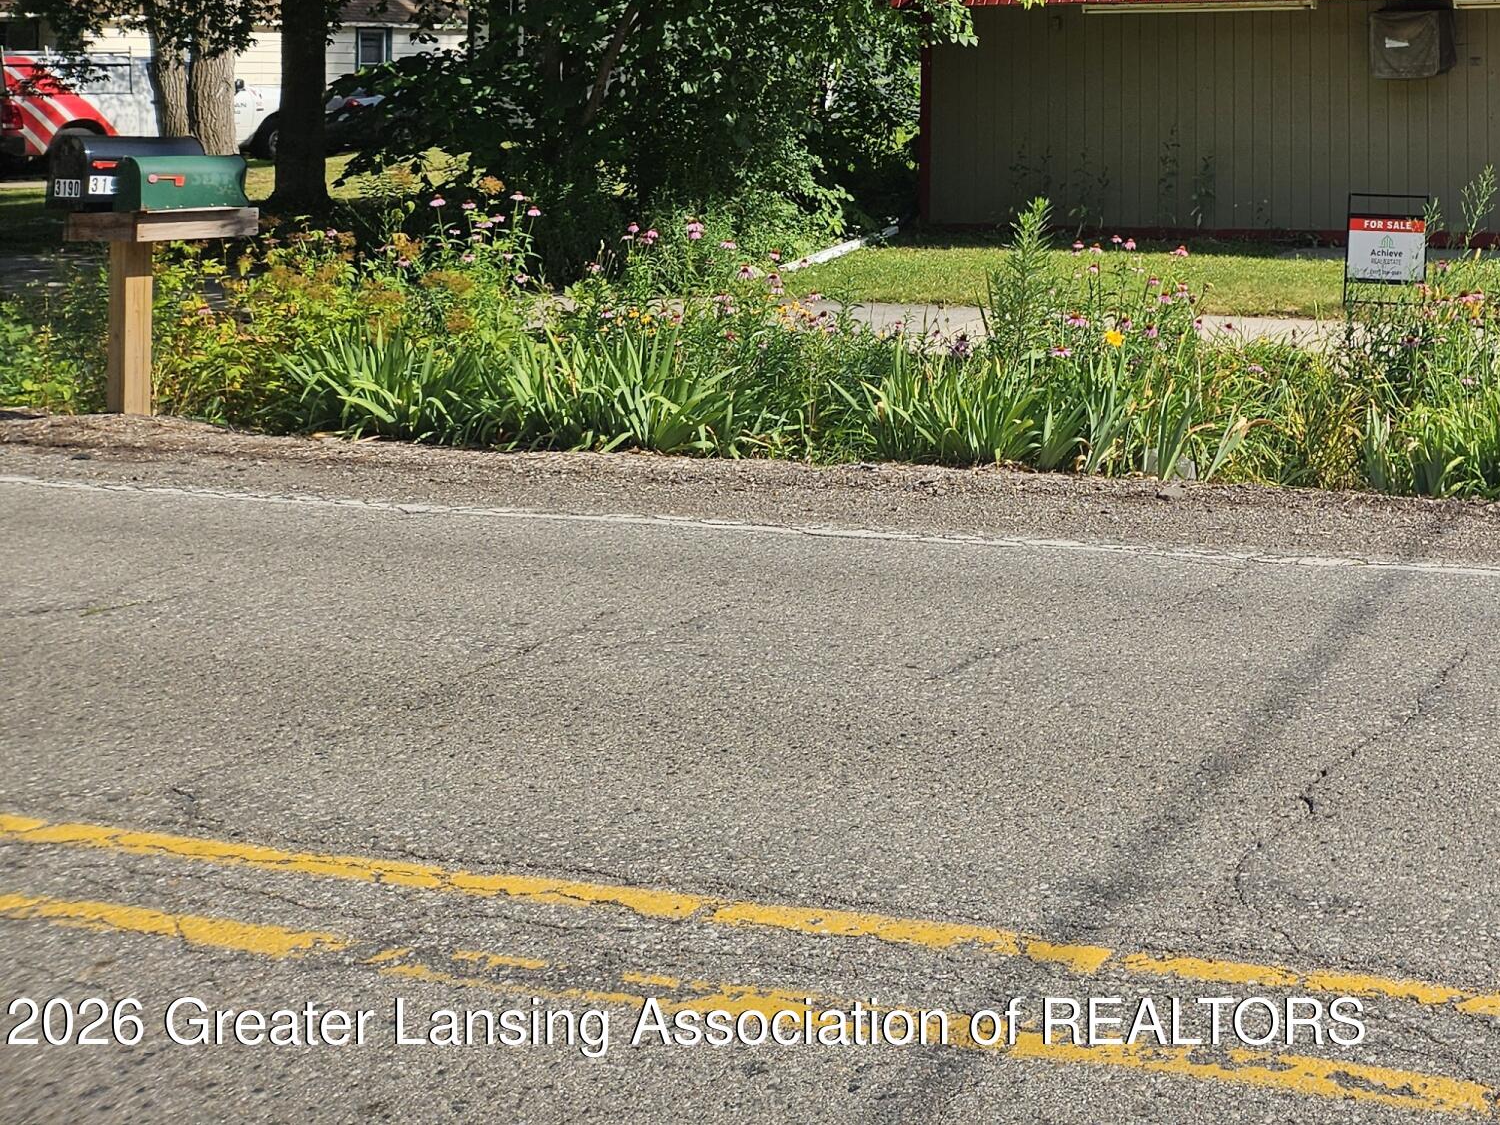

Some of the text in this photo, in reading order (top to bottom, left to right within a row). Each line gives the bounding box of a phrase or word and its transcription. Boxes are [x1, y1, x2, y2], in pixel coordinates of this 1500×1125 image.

[55, 179, 80, 197] 3190
[1363, 219, 1413, 230] FOR SALE
[1370, 249, 1403, 257] Achieve
